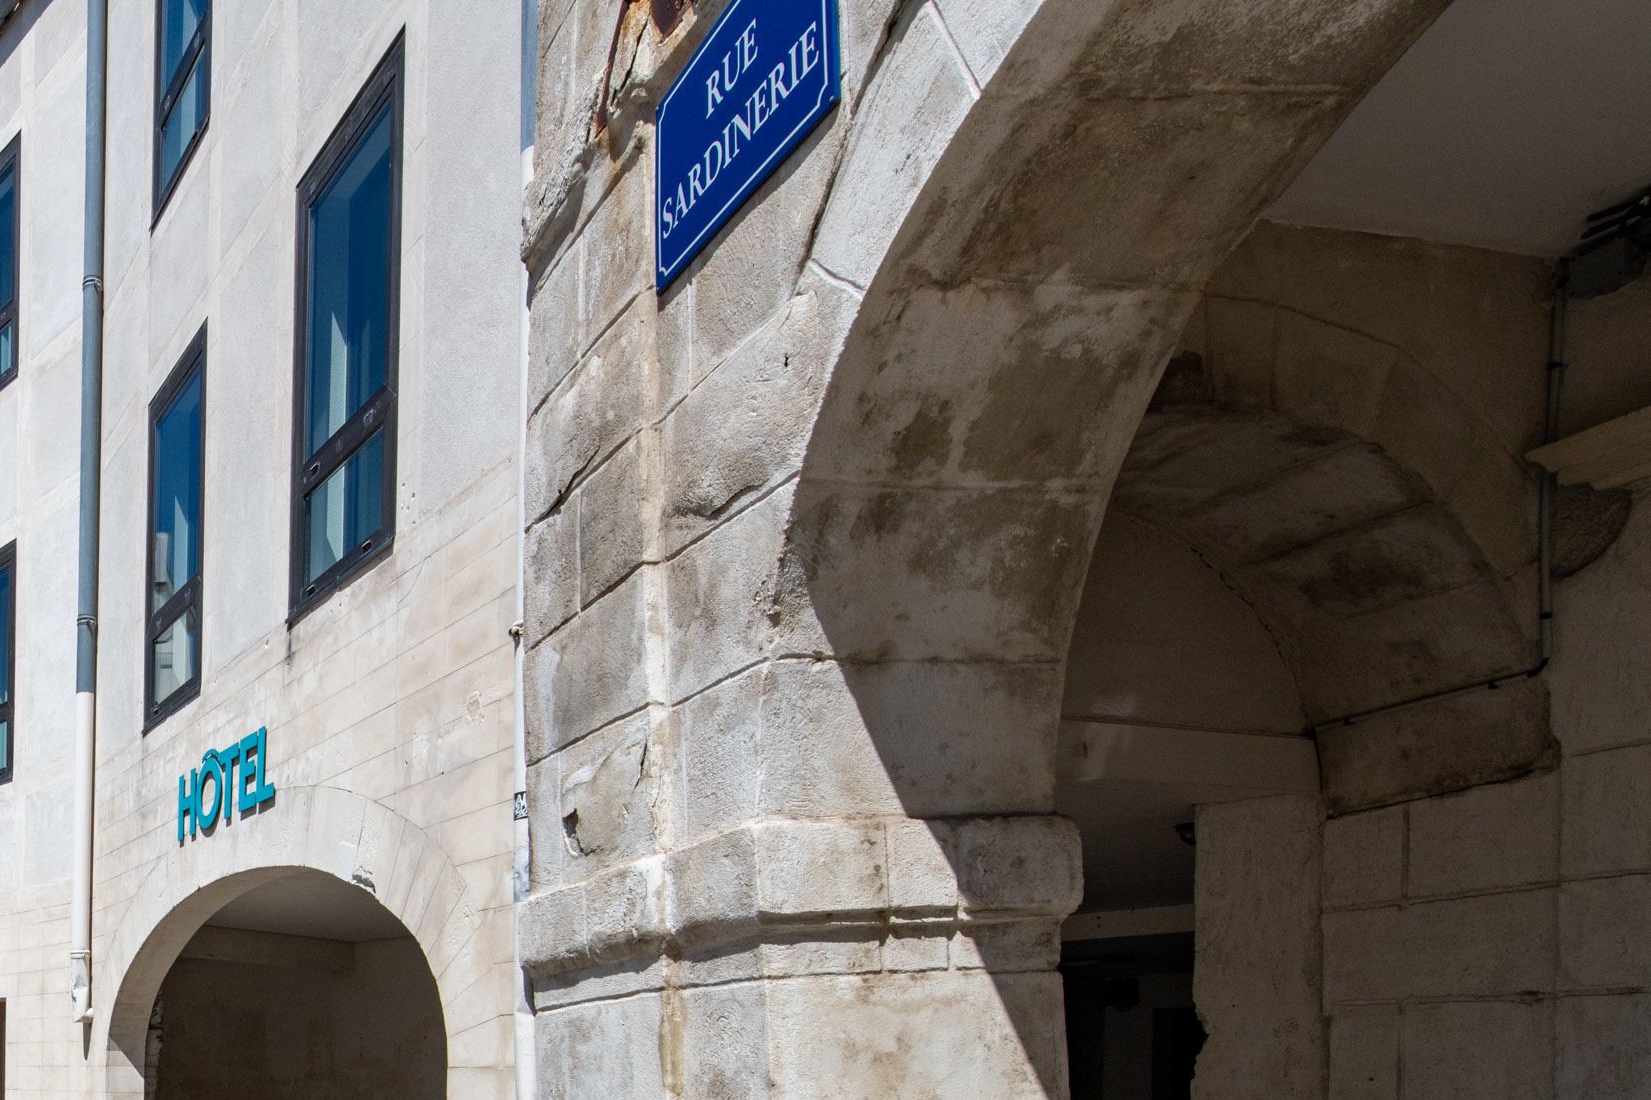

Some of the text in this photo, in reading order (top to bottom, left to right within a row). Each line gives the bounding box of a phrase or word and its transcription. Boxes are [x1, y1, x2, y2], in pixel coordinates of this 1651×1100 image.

[705, 18, 759, 119] RUE
[662, 21, 820, 239] SARDINERIE
[177, 726, 275, 842] HÔTEL
